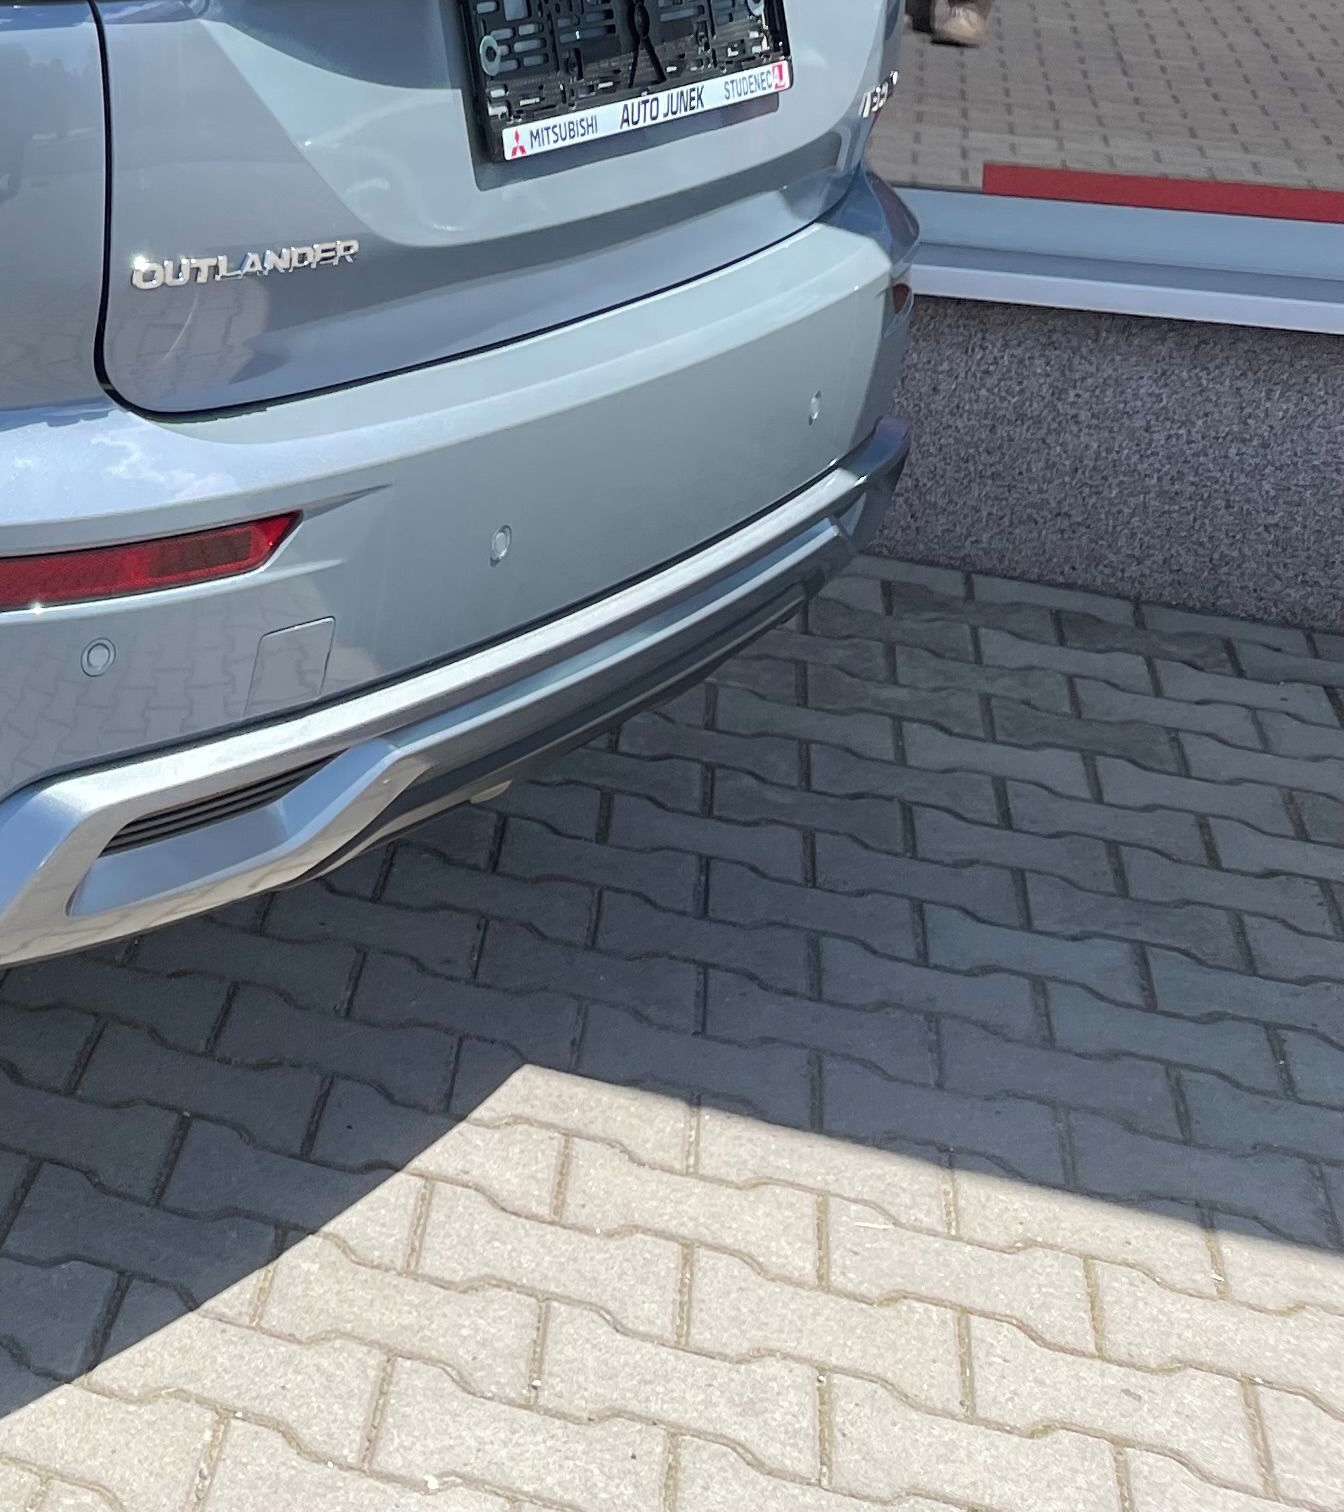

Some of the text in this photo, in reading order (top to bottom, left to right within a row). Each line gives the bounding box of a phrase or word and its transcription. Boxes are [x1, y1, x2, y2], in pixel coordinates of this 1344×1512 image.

[529, 69, 773, 150] MITSUBISHI AUTO JUNEK STUDENEC
[131, 239, 360, 290] OUTLANDER
